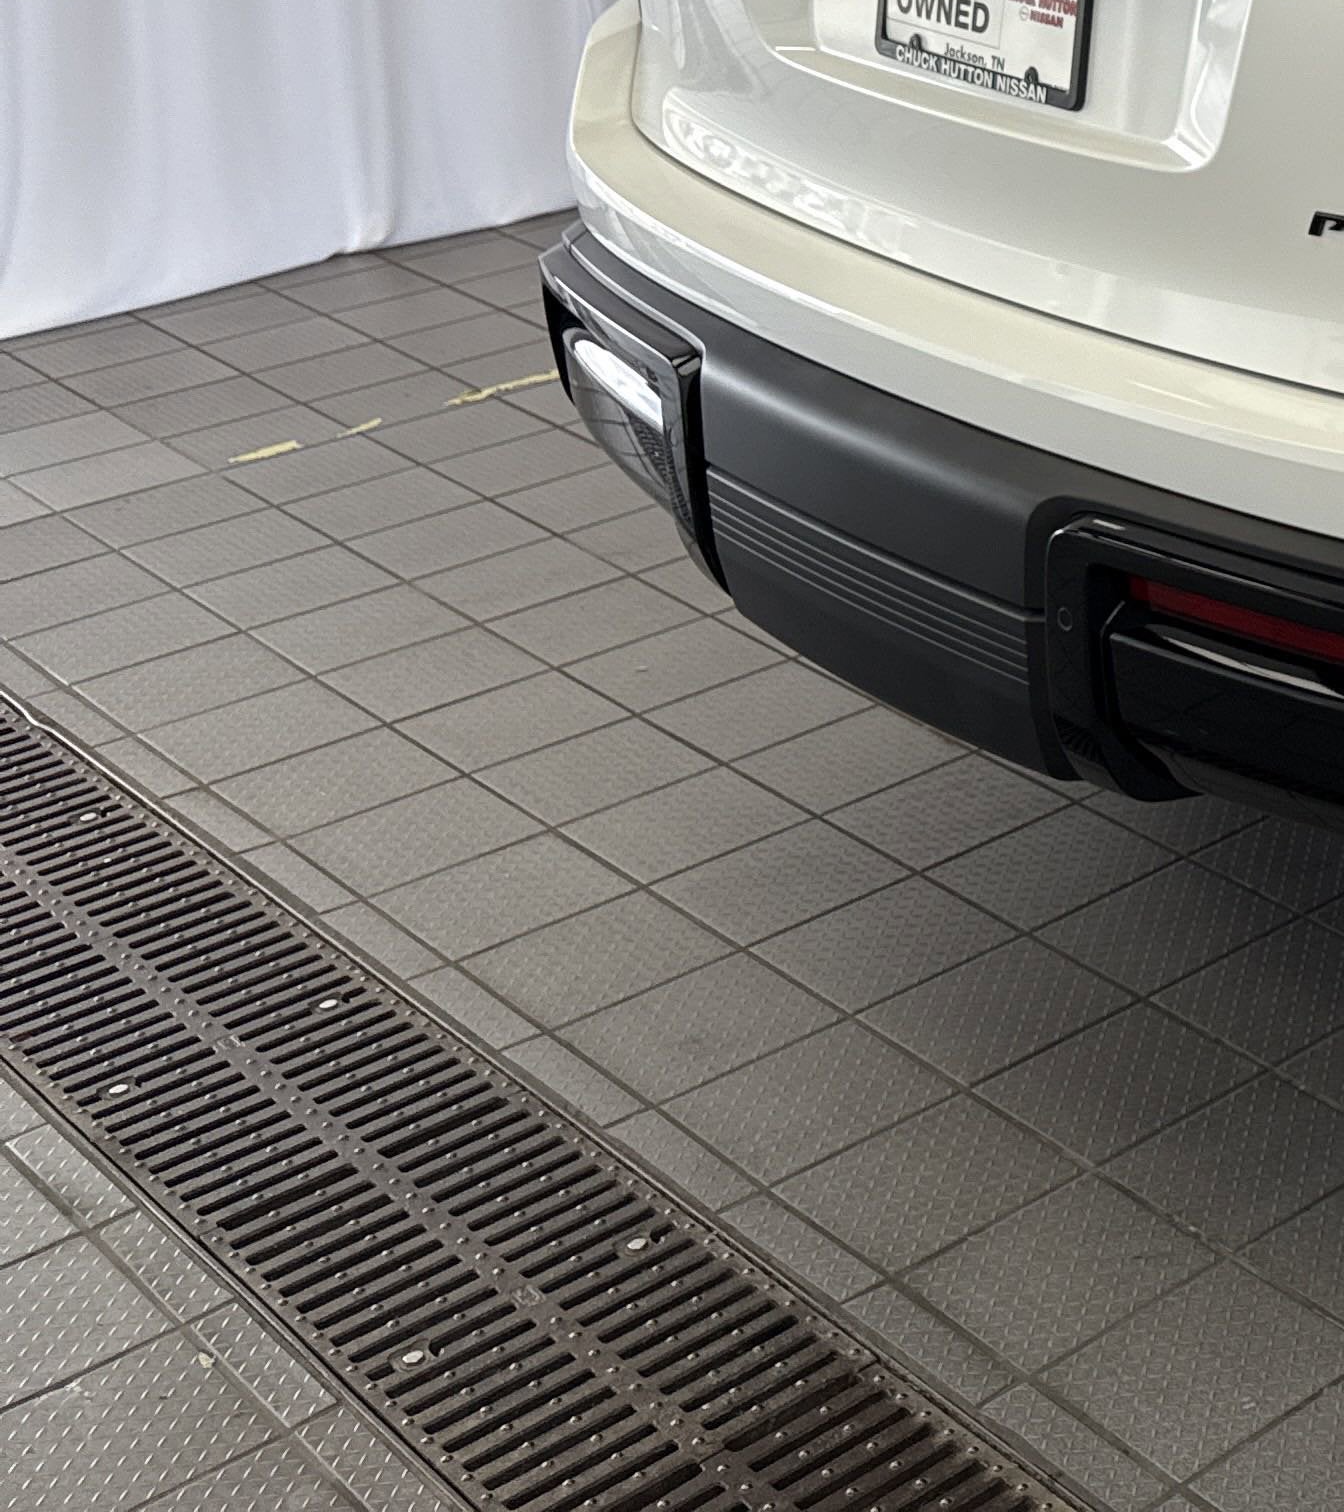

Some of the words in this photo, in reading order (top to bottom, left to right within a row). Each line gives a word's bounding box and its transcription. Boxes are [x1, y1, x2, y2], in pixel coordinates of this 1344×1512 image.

[1029, 9, 1064, 28] NISSAN
[944, 42, 987, 68] Jackson,
[991, 55, 1006, 71] TN
[896, 45, 938, 73] CHUCK
[940, 57, 993, 88] HUTTON
[996, 74, 1047, 104] NISSAN
